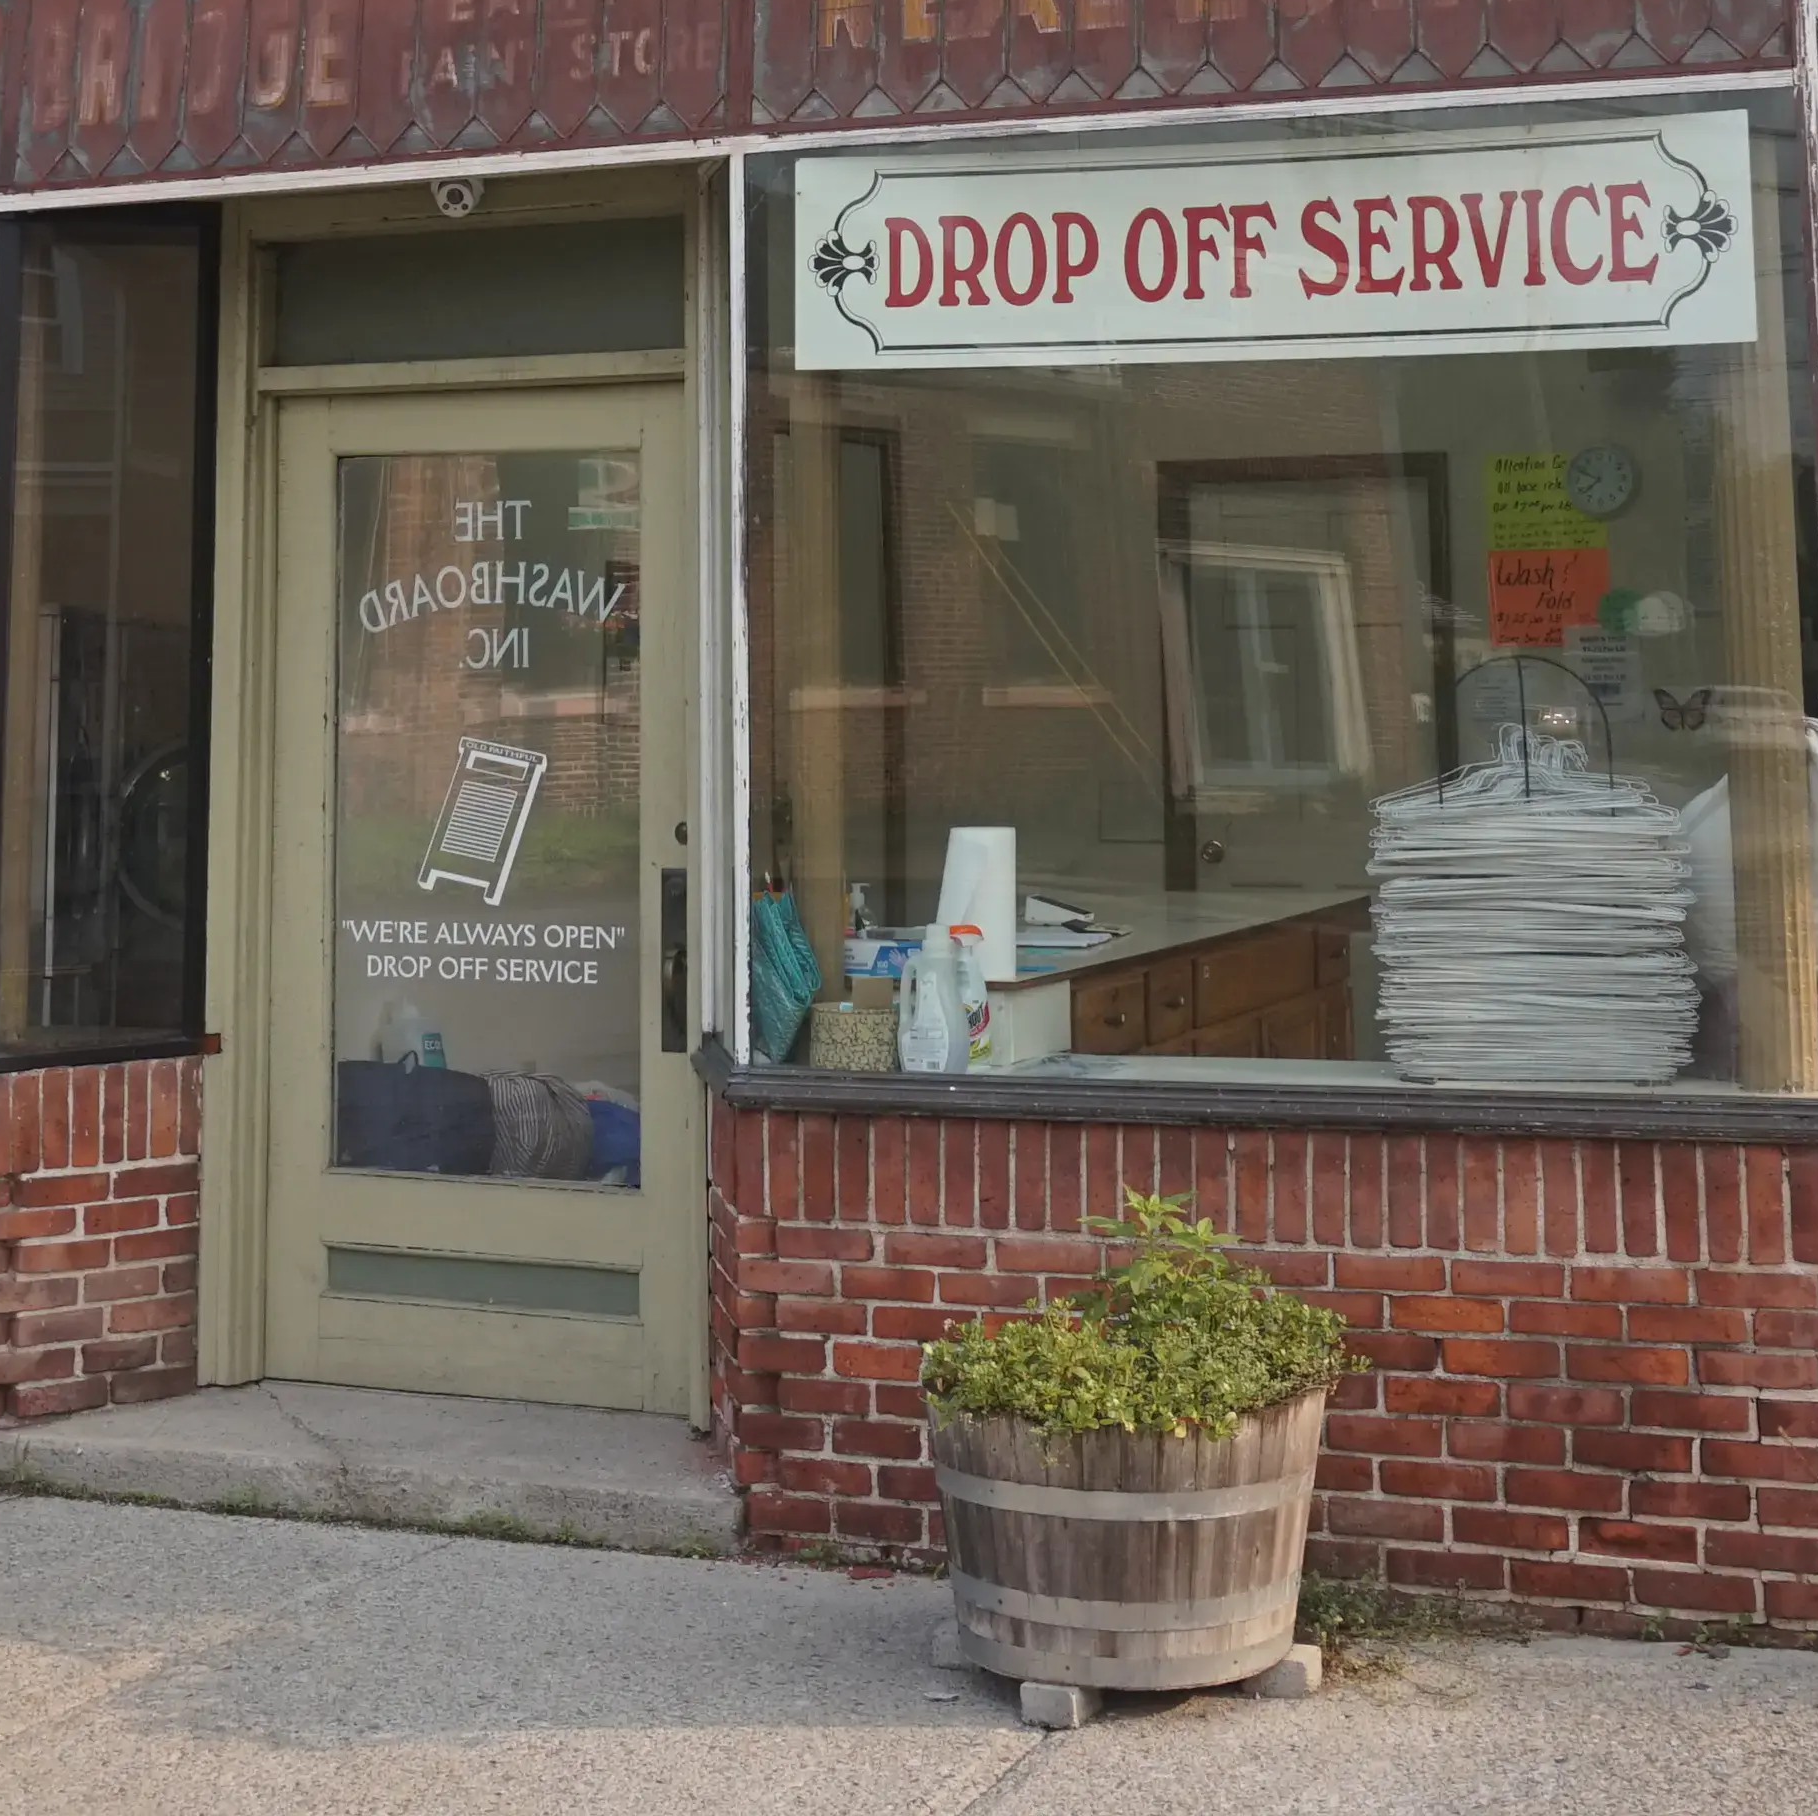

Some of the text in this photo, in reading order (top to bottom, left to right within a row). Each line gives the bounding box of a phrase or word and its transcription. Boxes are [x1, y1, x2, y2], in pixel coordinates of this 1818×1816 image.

[883, 179, 1660, 310] DROP OFF SERVICE
[1496, 556, 1555, 592] Wash
[1535, 590, 1576, 610] Fold
[341, 919, 626, 950] "WE'RE ALWAYS OPEN"
[367, 954, 599, 985] DROP OFF SERVICE
